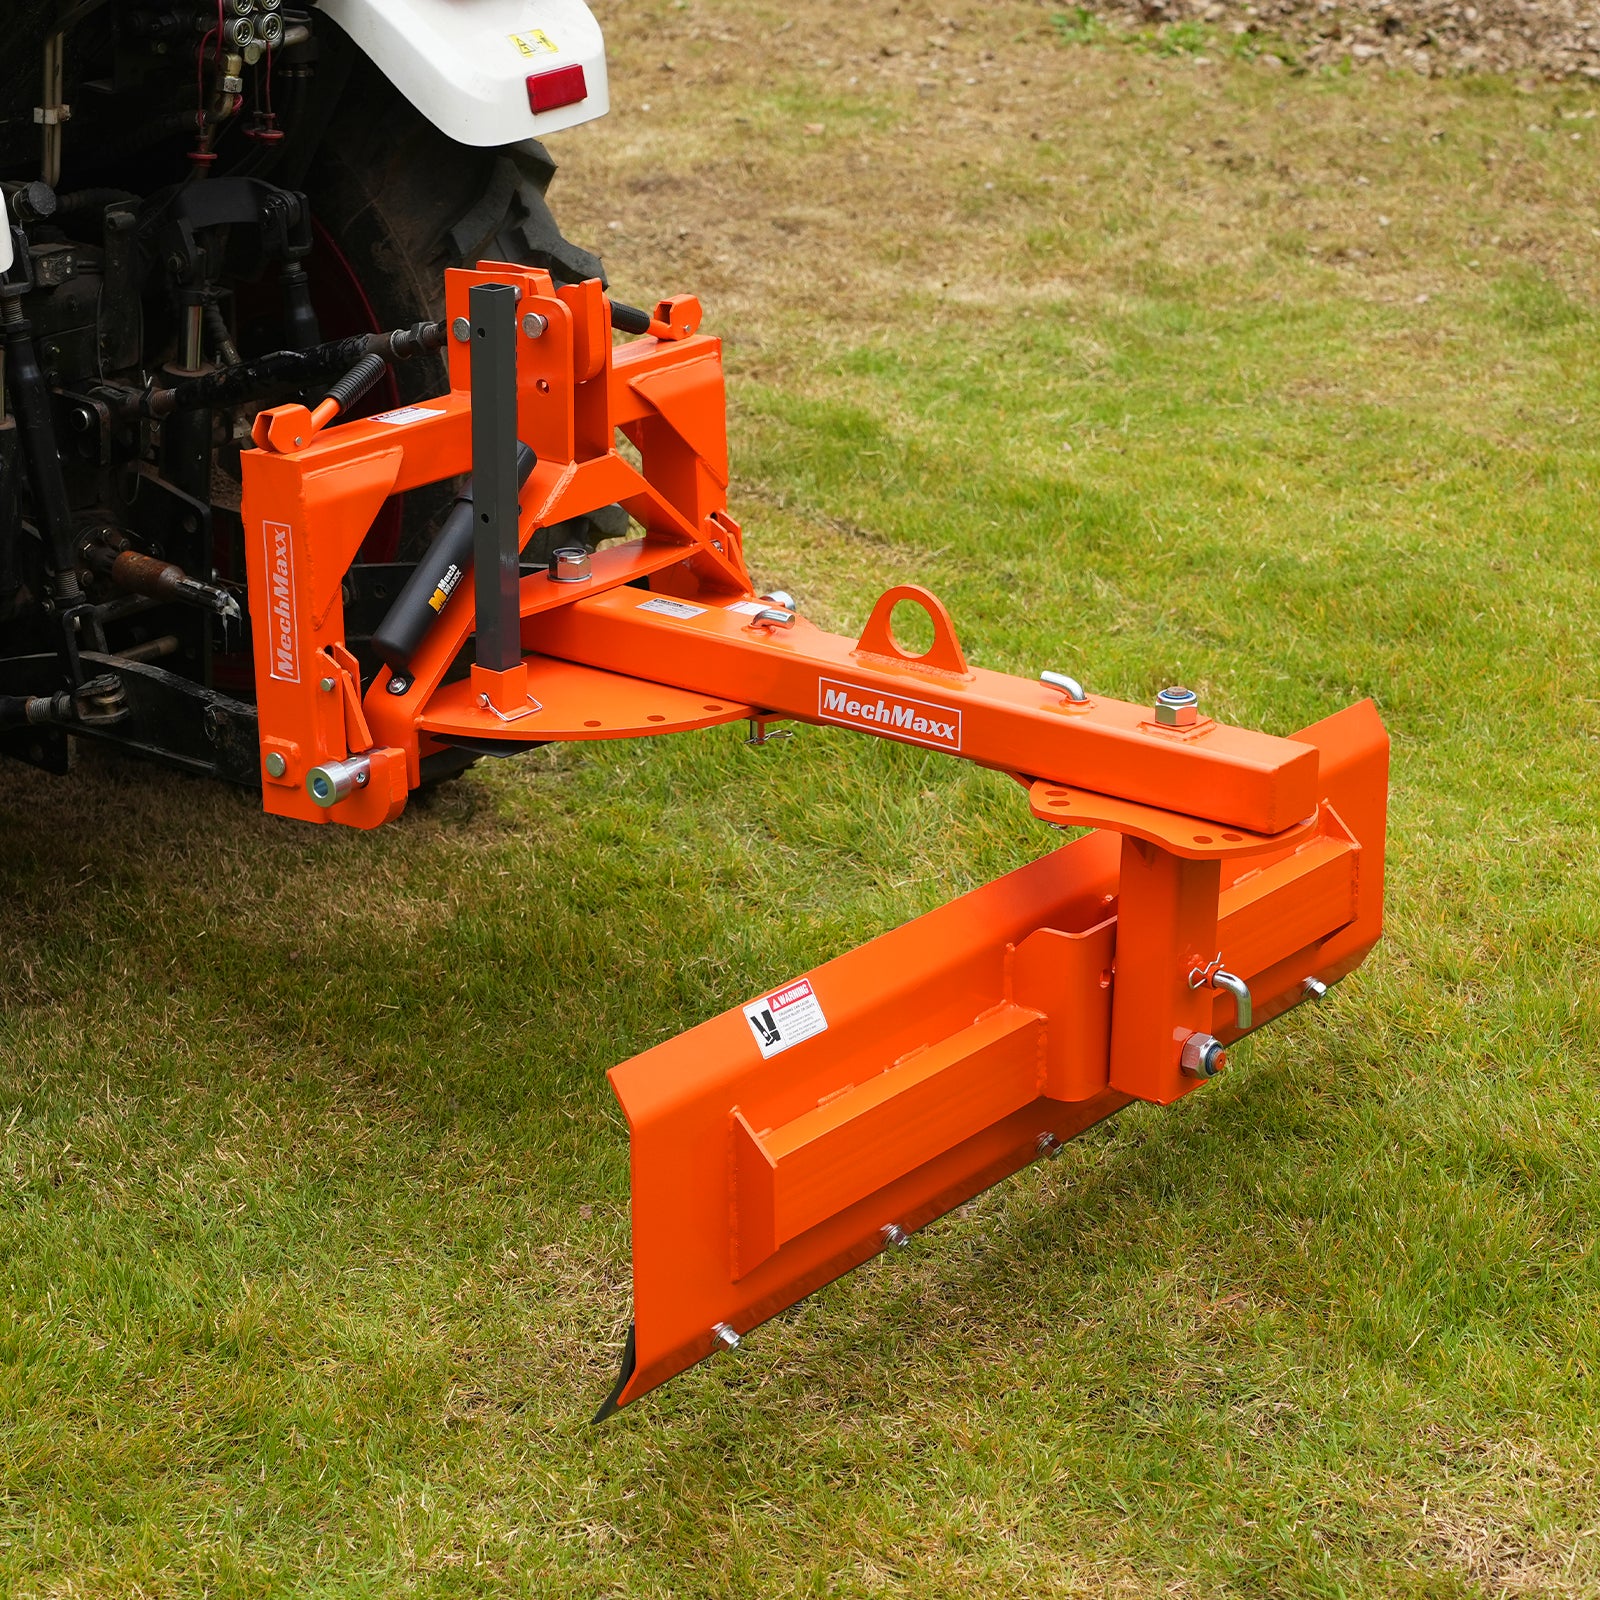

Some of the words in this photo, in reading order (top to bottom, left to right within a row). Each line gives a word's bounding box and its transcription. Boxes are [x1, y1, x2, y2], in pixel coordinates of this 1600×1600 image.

[437, 564, 458, 590] Mech
[443, 569, 462, 595] Maxx
[273, 528, 294, 676] MechMaxx
[823, 689, 956, 740] MechMaxx
[777, 984, 810, 1006] WARNING
